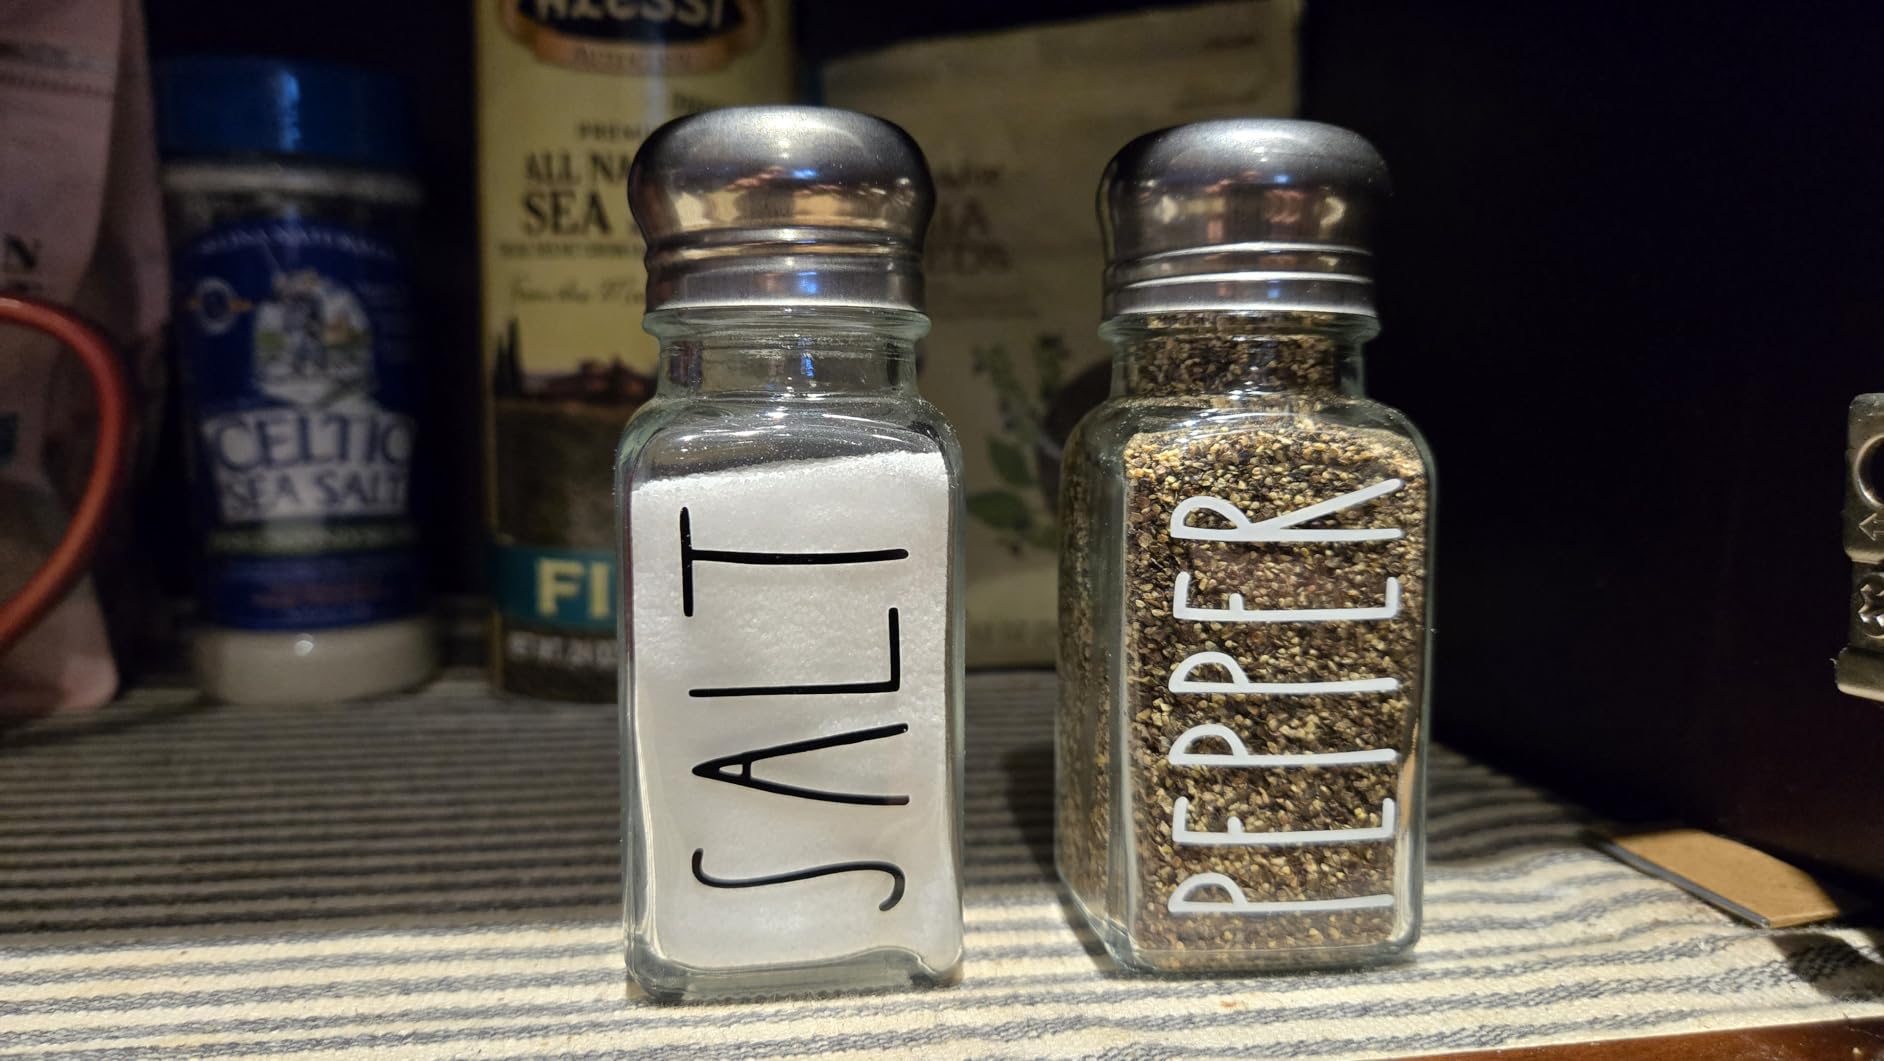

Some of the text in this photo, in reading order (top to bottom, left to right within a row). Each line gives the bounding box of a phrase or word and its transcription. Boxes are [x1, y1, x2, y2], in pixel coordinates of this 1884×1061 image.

[521, 190, 612, 235] SEA
[214, 408, 413, 471] CELTIC
[225, 468, 413, 516] SEA SALT
[680, 507, 909, 911] SALT
[1168, 479, 1403, 917] PEPPER
